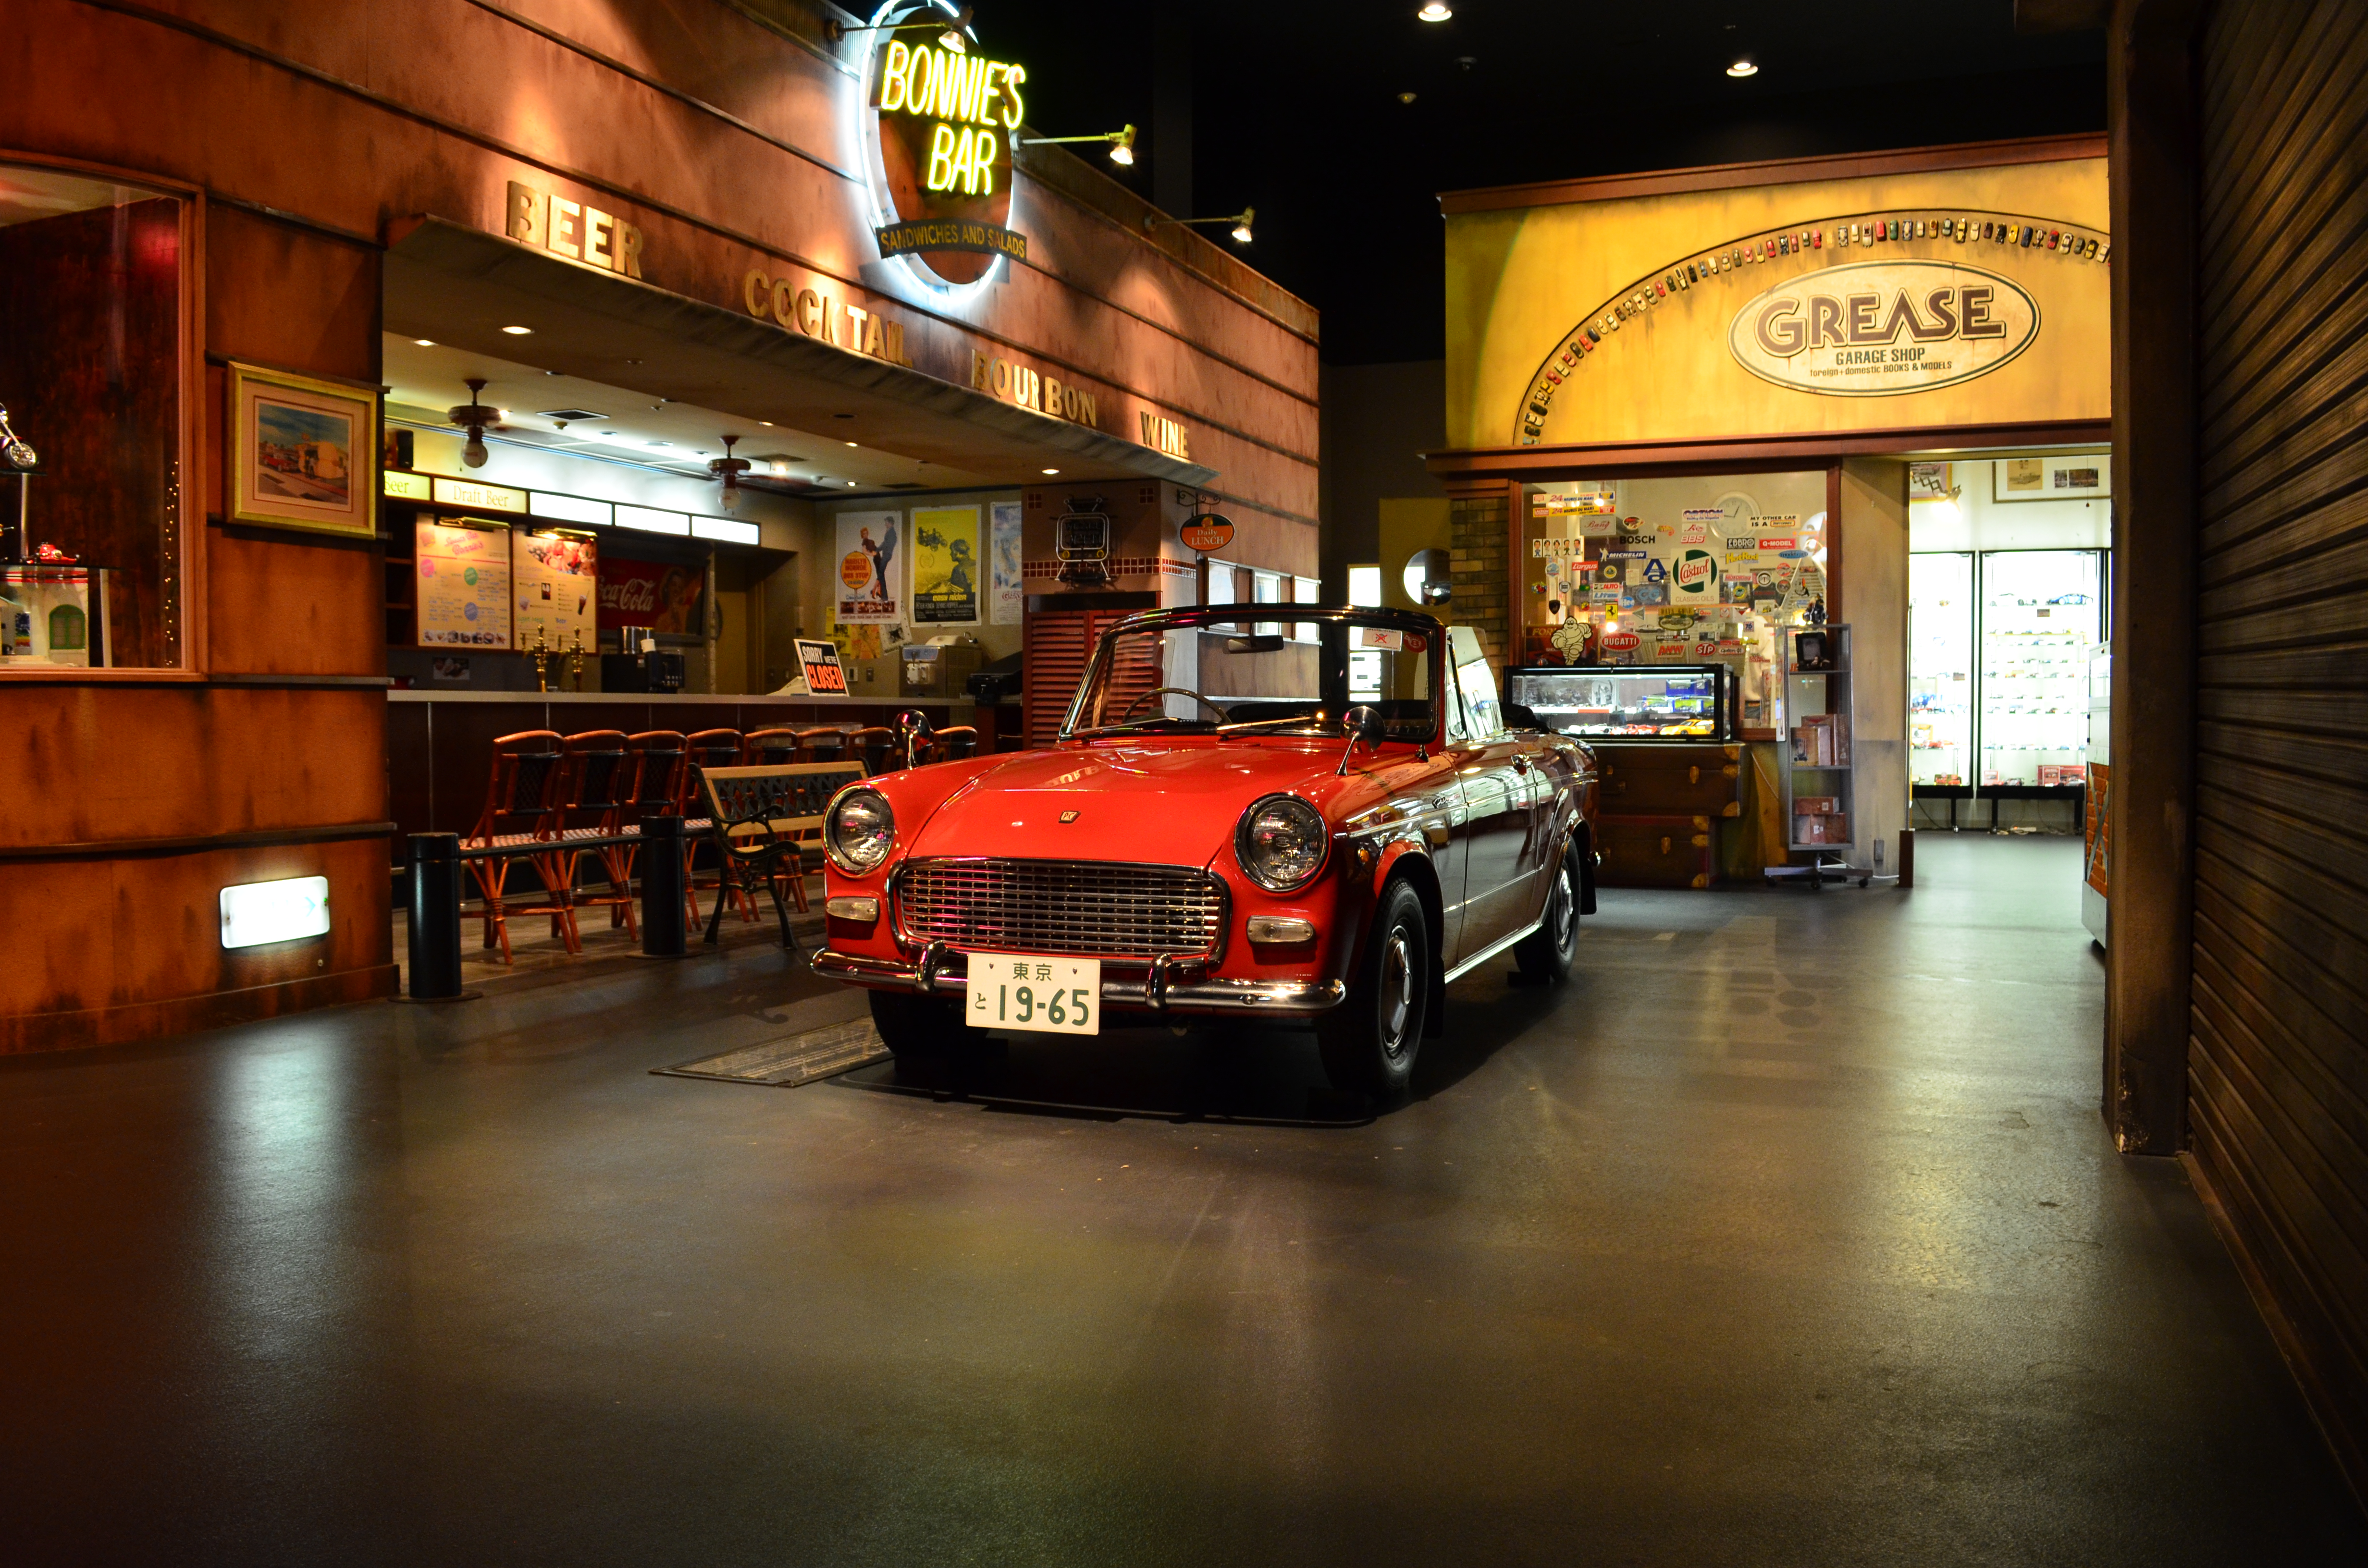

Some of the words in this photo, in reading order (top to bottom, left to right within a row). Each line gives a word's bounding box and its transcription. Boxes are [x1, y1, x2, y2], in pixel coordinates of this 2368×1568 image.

[881, 39, 1026, 130] BONNIE'S
[927, 122, 997, 196] BAR
[507, 180, 643, 279] BEER
[880, 224, 959, 252] SANDWICHES
[962, 226, 985, 245] AND
[988, 230, 1025, 258] SALADS
[744, 268, 913, 368] COCKTAIL
[1754, 285, 2007, 358] GREASE
[1836, 349, 1887, 365] GARAGE
[1891, 347, 1925, 362] SHOP
[1883, 363, 1909, 372] BOOKS
[1912, 362, 1918, 370] &
[1921, 361, 1952, 370] MODELS
[972, 349, 1097, 427] BOURBON
[1140, 411, 1189, 458] WINE
[384, 475, 409, 493] Beer
[454, 485, 481, 503] Draft
[486, 490, 509, 507] Beer
[1683, 509, 1723, 518] OPTION
[1192, 536, 1224, 546] LUNCH
[1197, 529, 1218, 538] Daily
[1620, 535, 1655, 544] BOSCH
[1681, 535, 1706, 544] BBS
[1726, 552, 1758, 564] HotRod
[1680, 558, 1709, 583] Castrol
[1603, 637, 1637, 646] BUGATTI
[1697, 644, 1714, 655] STP
[802, 646, 823, 663] SORRY
[824, 656, 838, 664] WE'RE
[806, 664, 844, 689] CLOSED
[1012, 962, 1052, 981] 東京
[974, 992, 987, 1010] と
[999, 984, 1089, 1026] 19-65
